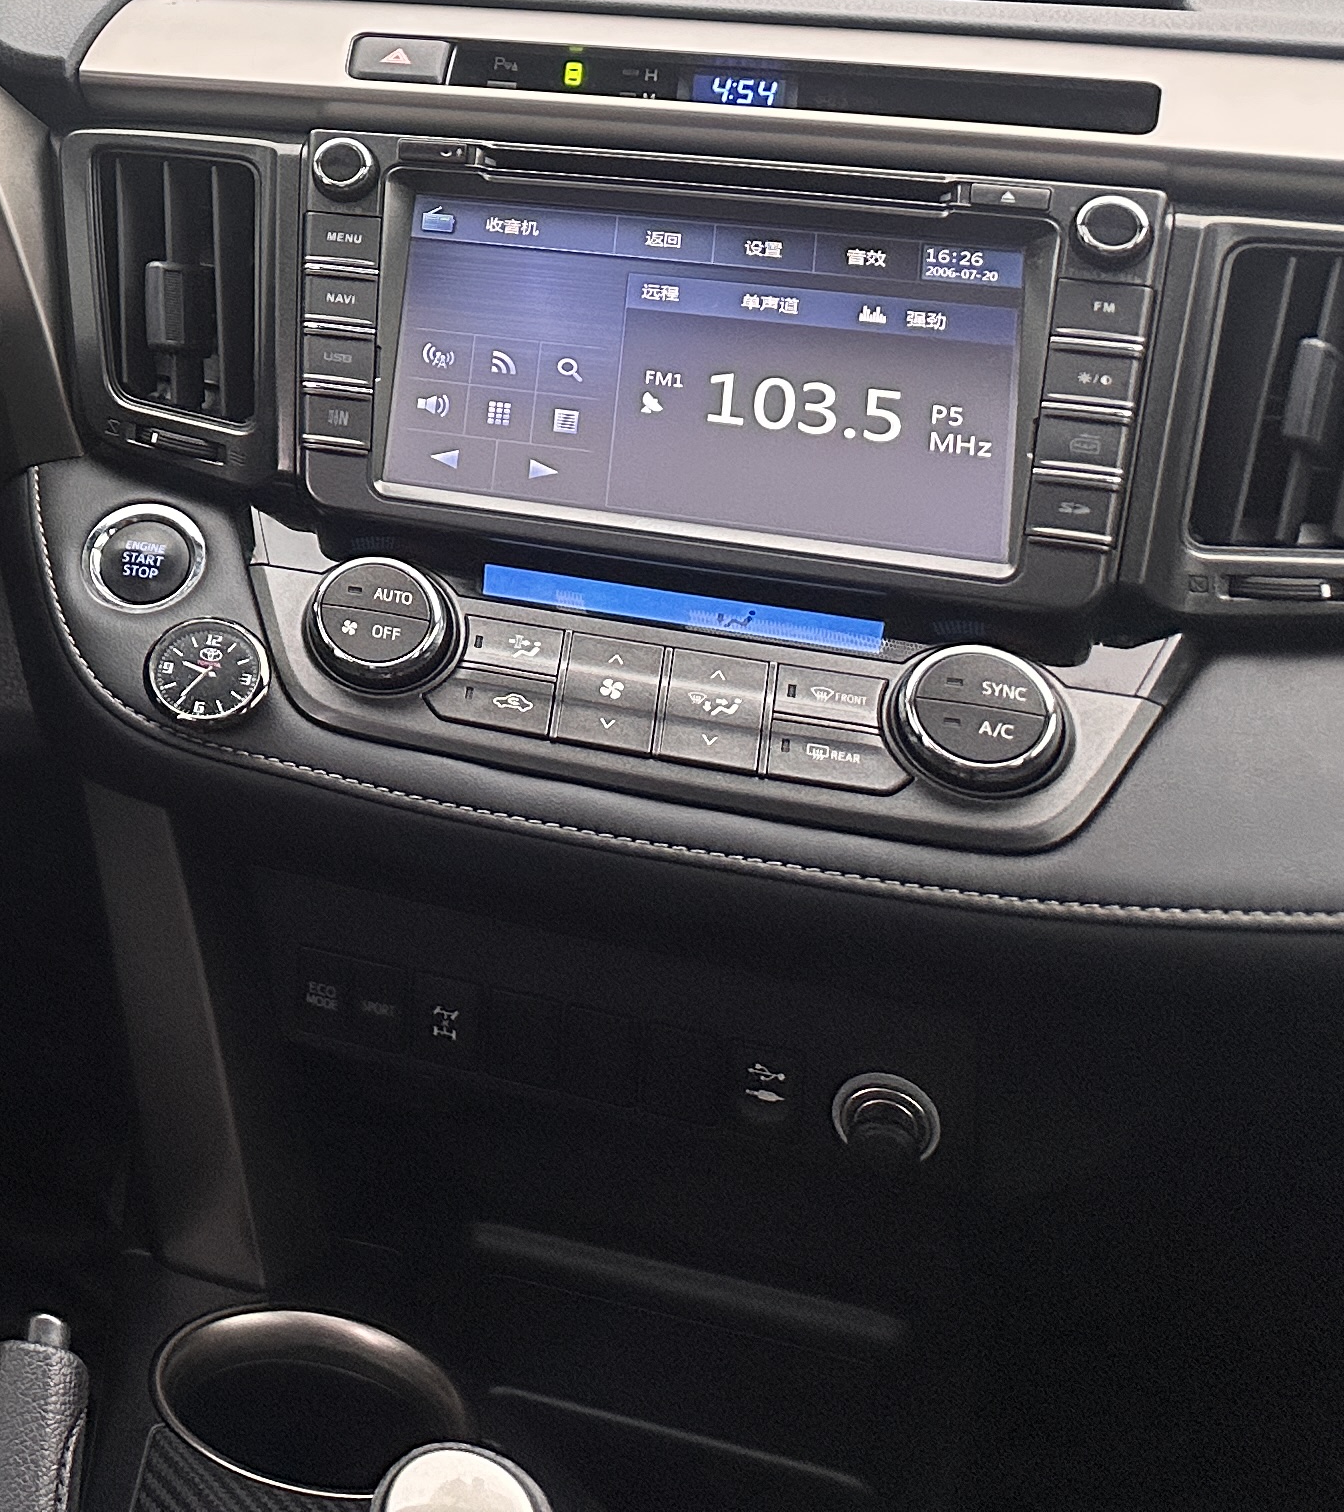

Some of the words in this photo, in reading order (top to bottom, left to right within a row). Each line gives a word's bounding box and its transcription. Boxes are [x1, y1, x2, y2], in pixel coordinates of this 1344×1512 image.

[710, 74, 778, 106] 4:54
[485, 216, 539, 237] 收音机
[326, 231, 362, 244] MENU
[644, 230, 682, 249] 返回
[744, 240, 784, 259] 设置
[846, 248, 886, 269] 音效
[925, 247, 984, 266] 16:26
[924, 265, 999, 283] 2006-07-20
[326, 293, 356, 305] NAVI
[641, 283, 680, 303] 远程
[740, 294, 800, 315] 单声道
[1093, 301, 1116, 314] FM
[906, 309, 948, 331] 强劲
[644, 370, 685, 388] FM1
[706, 371, 903, 443] 103.5
[930, 404, 964, 428] P5
[928, 431, 993, 459] MHz
[125, 539, 167, 555] ENGINE
[122, 551, 165, 568] START
[122, 564, 159, 579] STOP
[373, 587, 413, 606] AUTO
[205, 634, 223, 647] 12
[371, 624, 402, 642] OFF
[162, 662, 174, 674] 9
[240, 673, 253, 686] 3
[834, 691, 868, 707] FRONT
[981, 680, 1027, 703] SYNC
[193, 701, 205, 714] 6
[978, 720, 1014, 740] A/C
[830, 749, 861, 764] REAR
[308, 981, 337, 999] ECO
[306, 993, 339, 1011] MODE
